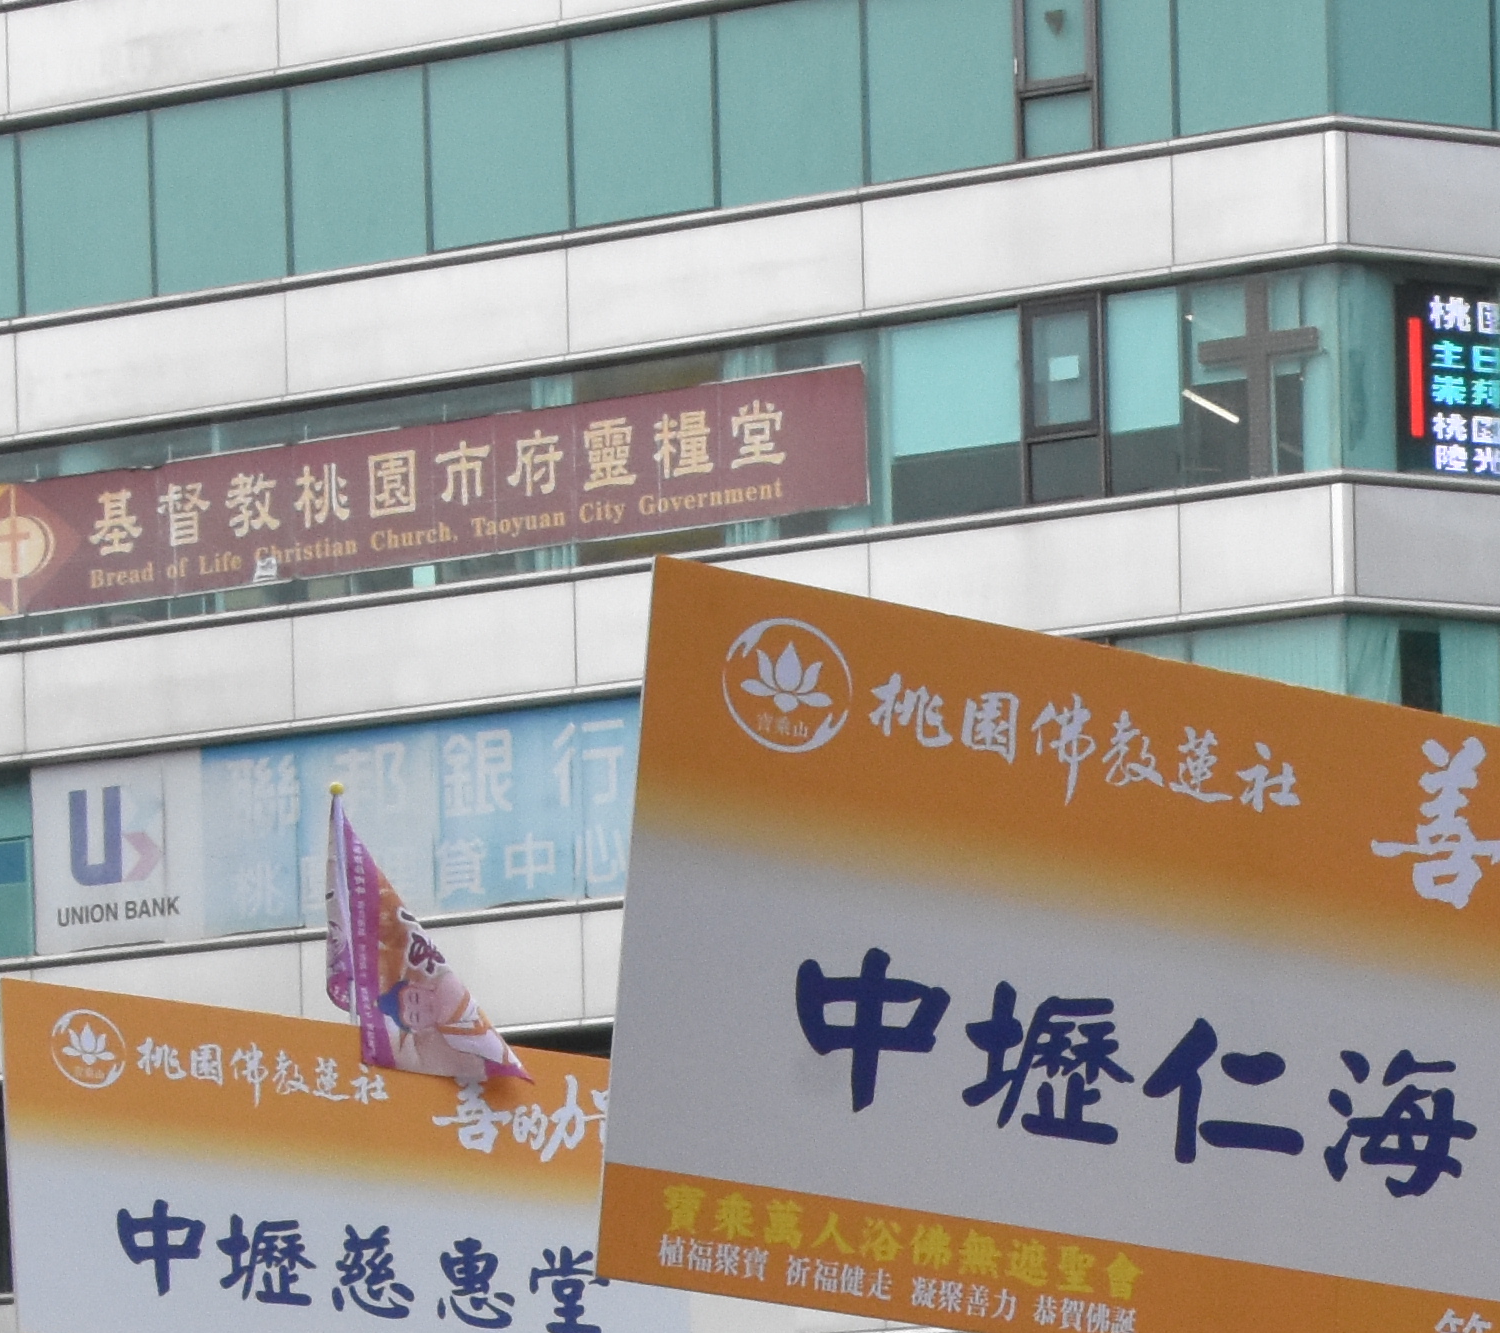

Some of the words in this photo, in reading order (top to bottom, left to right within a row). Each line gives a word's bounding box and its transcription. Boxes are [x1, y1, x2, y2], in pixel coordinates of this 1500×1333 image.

[88, 399, 788, 557] 基督教桃園市府靈糧堂
[89, 562, 155, 591] Bread
[165, 556, 187, 581] of
[198, 549, 243, 576] Life
[254, 535, 358, 568] Christian
[470, 508, 567, 541] Taoyuan
[578, 499, 626, 527] City
[638, 477, 784, 518] Government
[868, 671, 1301, 814] 桃園佛教蓮社
[56, 901, 120, 928] UNION
[123, 895, 181, 922] BANK
[136, 1037, 390, 1108] 桃園佛教蓮社
[431, 1074, 608, 1163] 善的力
[658, 1233, 771, 1283] 植福聚寶
[785, 1255, 893, 1302] 祈福健走
